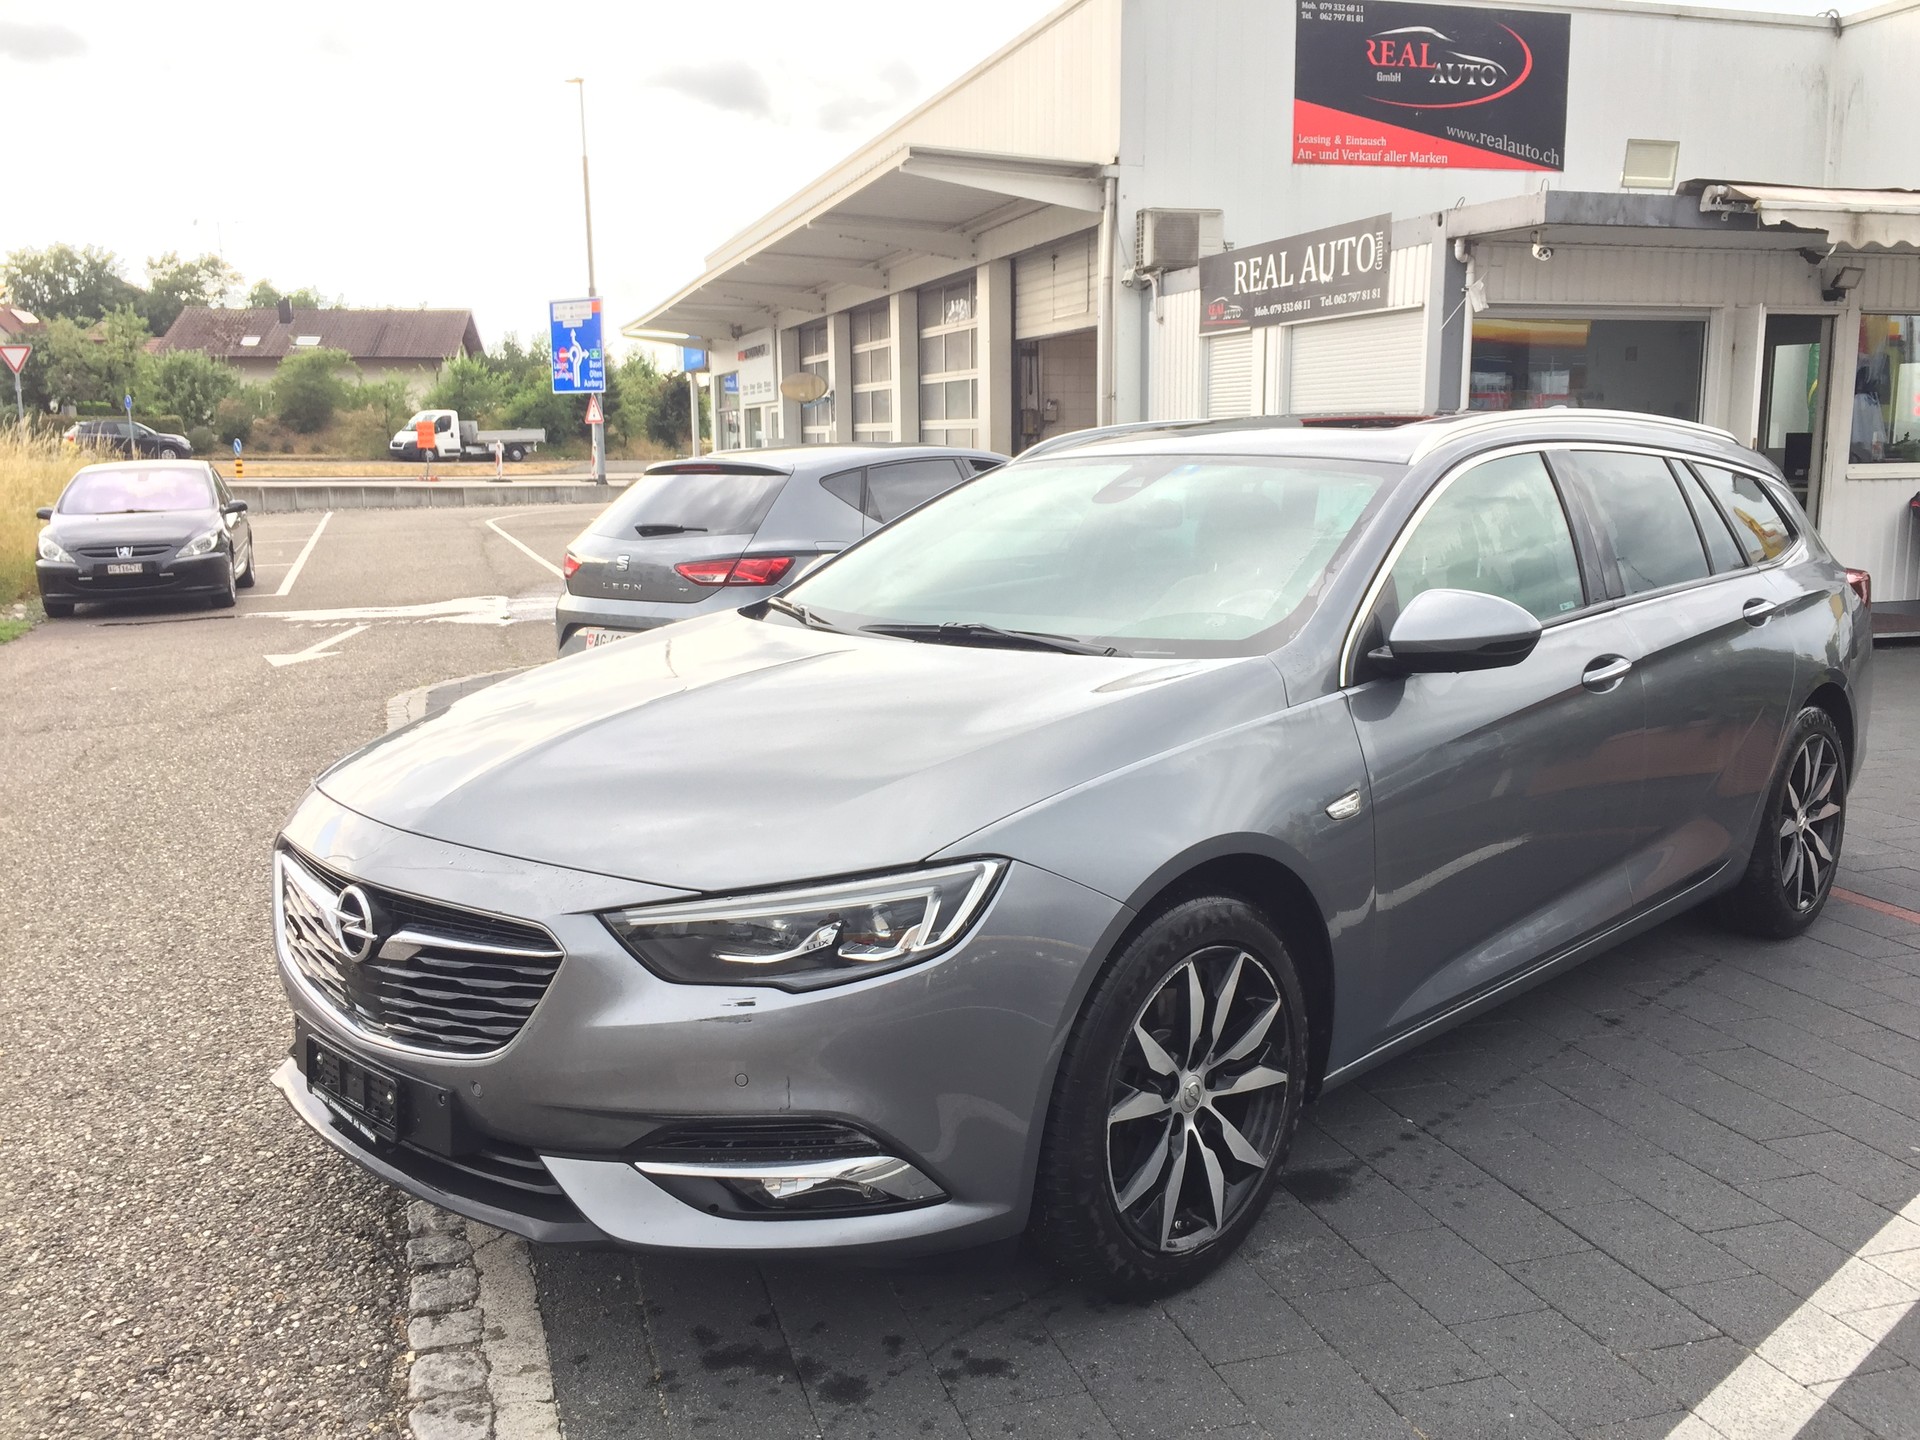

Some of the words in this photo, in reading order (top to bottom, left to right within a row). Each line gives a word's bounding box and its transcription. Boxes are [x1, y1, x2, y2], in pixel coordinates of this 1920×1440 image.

[1301, 1, 1317, 10] Mob.
[1319, 2, 1332, 10] 079
[1333, 3, 1345, 12] 332
[1346, 4, 1355, 12] 68
[1319, 13, 1332, 21] 062
[1333, 13, 1345, 21] 797
[1346, 14, 1354, 22] 81
[1366, 39, 1437, 69] REAL
[1377, 72, 1401, 83] GmbH
[1429, 63, 1498, 87] AUTO
[1298, 134, 1330, 147] Leasing
[1334, 135, 1342, 145] &
[1345, 135, 1386, 147] Eintausch
[1446, 126, 1559, 165] www.realauto.ch
[1297, 148, 1316, 159] An-
[1319, 149, 1338, 160] und
[1342, 150, 1382, 161] Verkauf
[1384, 151, 1407, 163] aller
[1410, 152, 1448, 164] Marken
[1375, 231, 1384, 271] GmbH
[1233, 251, 1294, 295] REAL
[1299, 232, 1376, 284] AUTO
[1270, 303, 1282, 315] 079
[1282, 302, 1294, 313] 332
[1294, 300, 1303, 311] 68
[1303, 299, 1311, 310] 11
[1334, 293, 1347, 305] 062
[1348, 290, 1361, 303] 797
[1361, 289, 1370, 301] 81
[1371, 288, 1381, 299] 81
[602, 582, 642, 591] LEON
